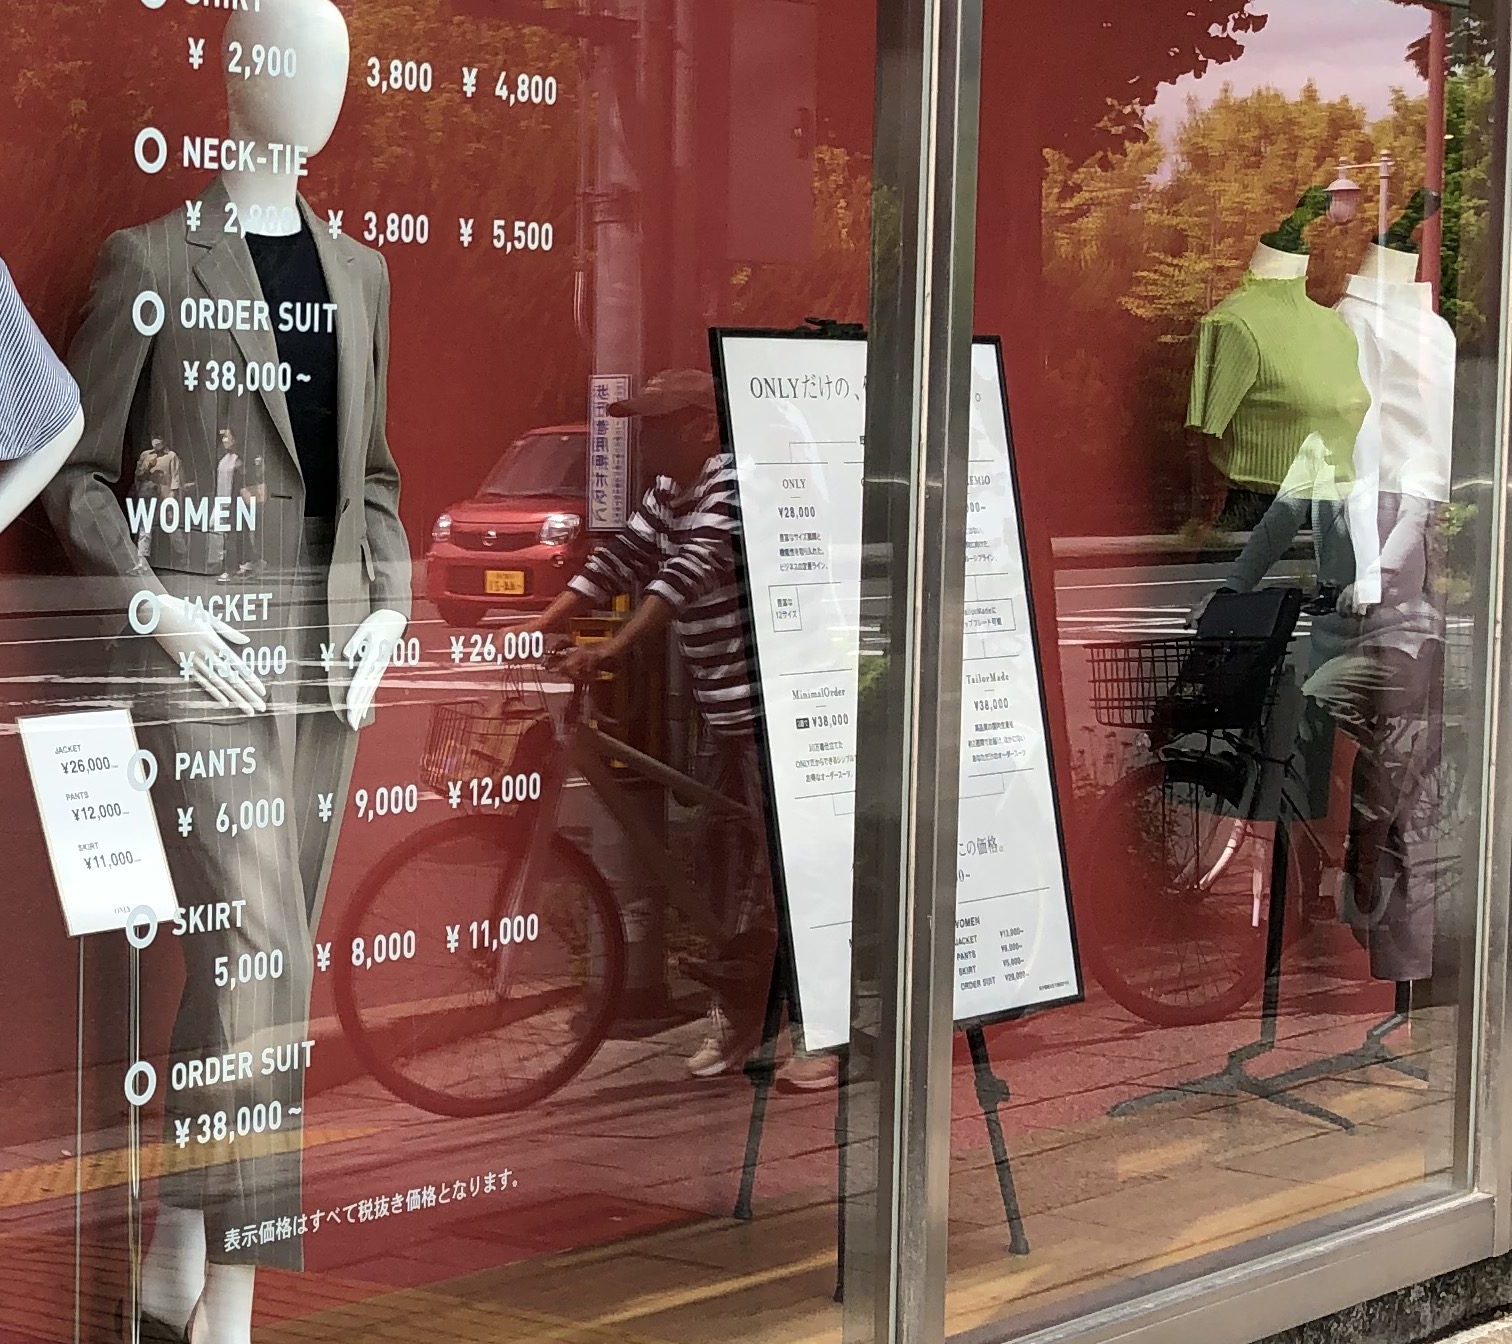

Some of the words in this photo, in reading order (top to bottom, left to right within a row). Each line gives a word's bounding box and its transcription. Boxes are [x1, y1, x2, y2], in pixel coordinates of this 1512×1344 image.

[366, 56, 432, 94] 3,800
[182, 135, 309, 176] NECK-TIE
[180, 298, 269, 331] ORDER
[278, 302, 338, 334] SUIT
[750, 374, 867, 401] ONLYだけの、
[782, 478, 806, 489] ONLY
[126, 496, 257, 534] WOMEN
[778, 506, 816, 520] ¥28,000
[792, 686, 846, 700] MinimalOrder
[966, 672, 1009, 685] TailorMade
[812, 713, 849, 728] ¥38,000
[55, 744, 82, 755] JACKET
[175, 746, 257, 781] PANTS
[65, 791, 89, 801] PANTS
[78, 842, 99, 852] SKIRT
[172, 900, 247, 936] SKIRT
[214, 948, 284, 991] 5,000
[171, 1050, 252, 1091] ORDER
[261, 1040, 316, 1073] SUIT
[223, 1168, 519, 1253] 表示価格はすべて税抜き価格となります。
